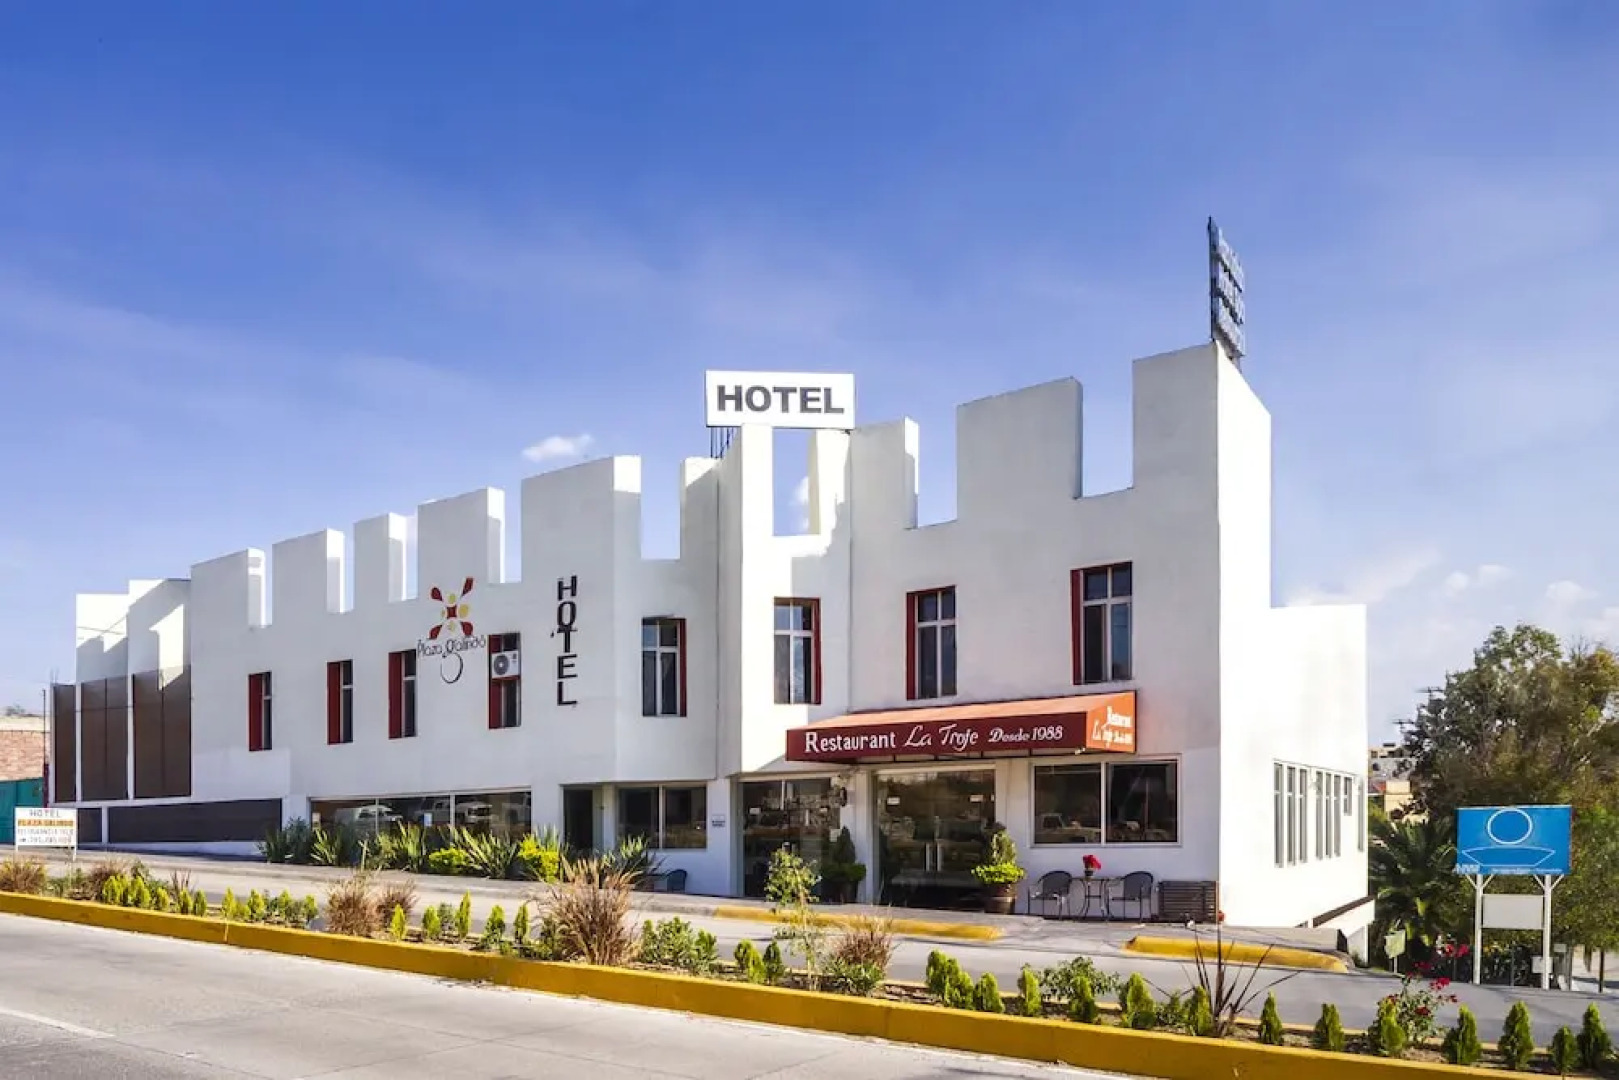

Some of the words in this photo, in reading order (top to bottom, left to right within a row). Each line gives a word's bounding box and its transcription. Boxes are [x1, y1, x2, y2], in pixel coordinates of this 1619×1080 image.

[717, 385, 845, 414] HOTEL
[557, 574, 578, 706] HOTEL
[804, 731, 896, 753] Restaurant
[904, 724, 933, 747] La
[938, 723, 979, 752] Troje
[988, 727, 1030, 743] Desde
[1031, 725, 1064, 741] 1988
[29, 809, 61, 818] HOTEL
